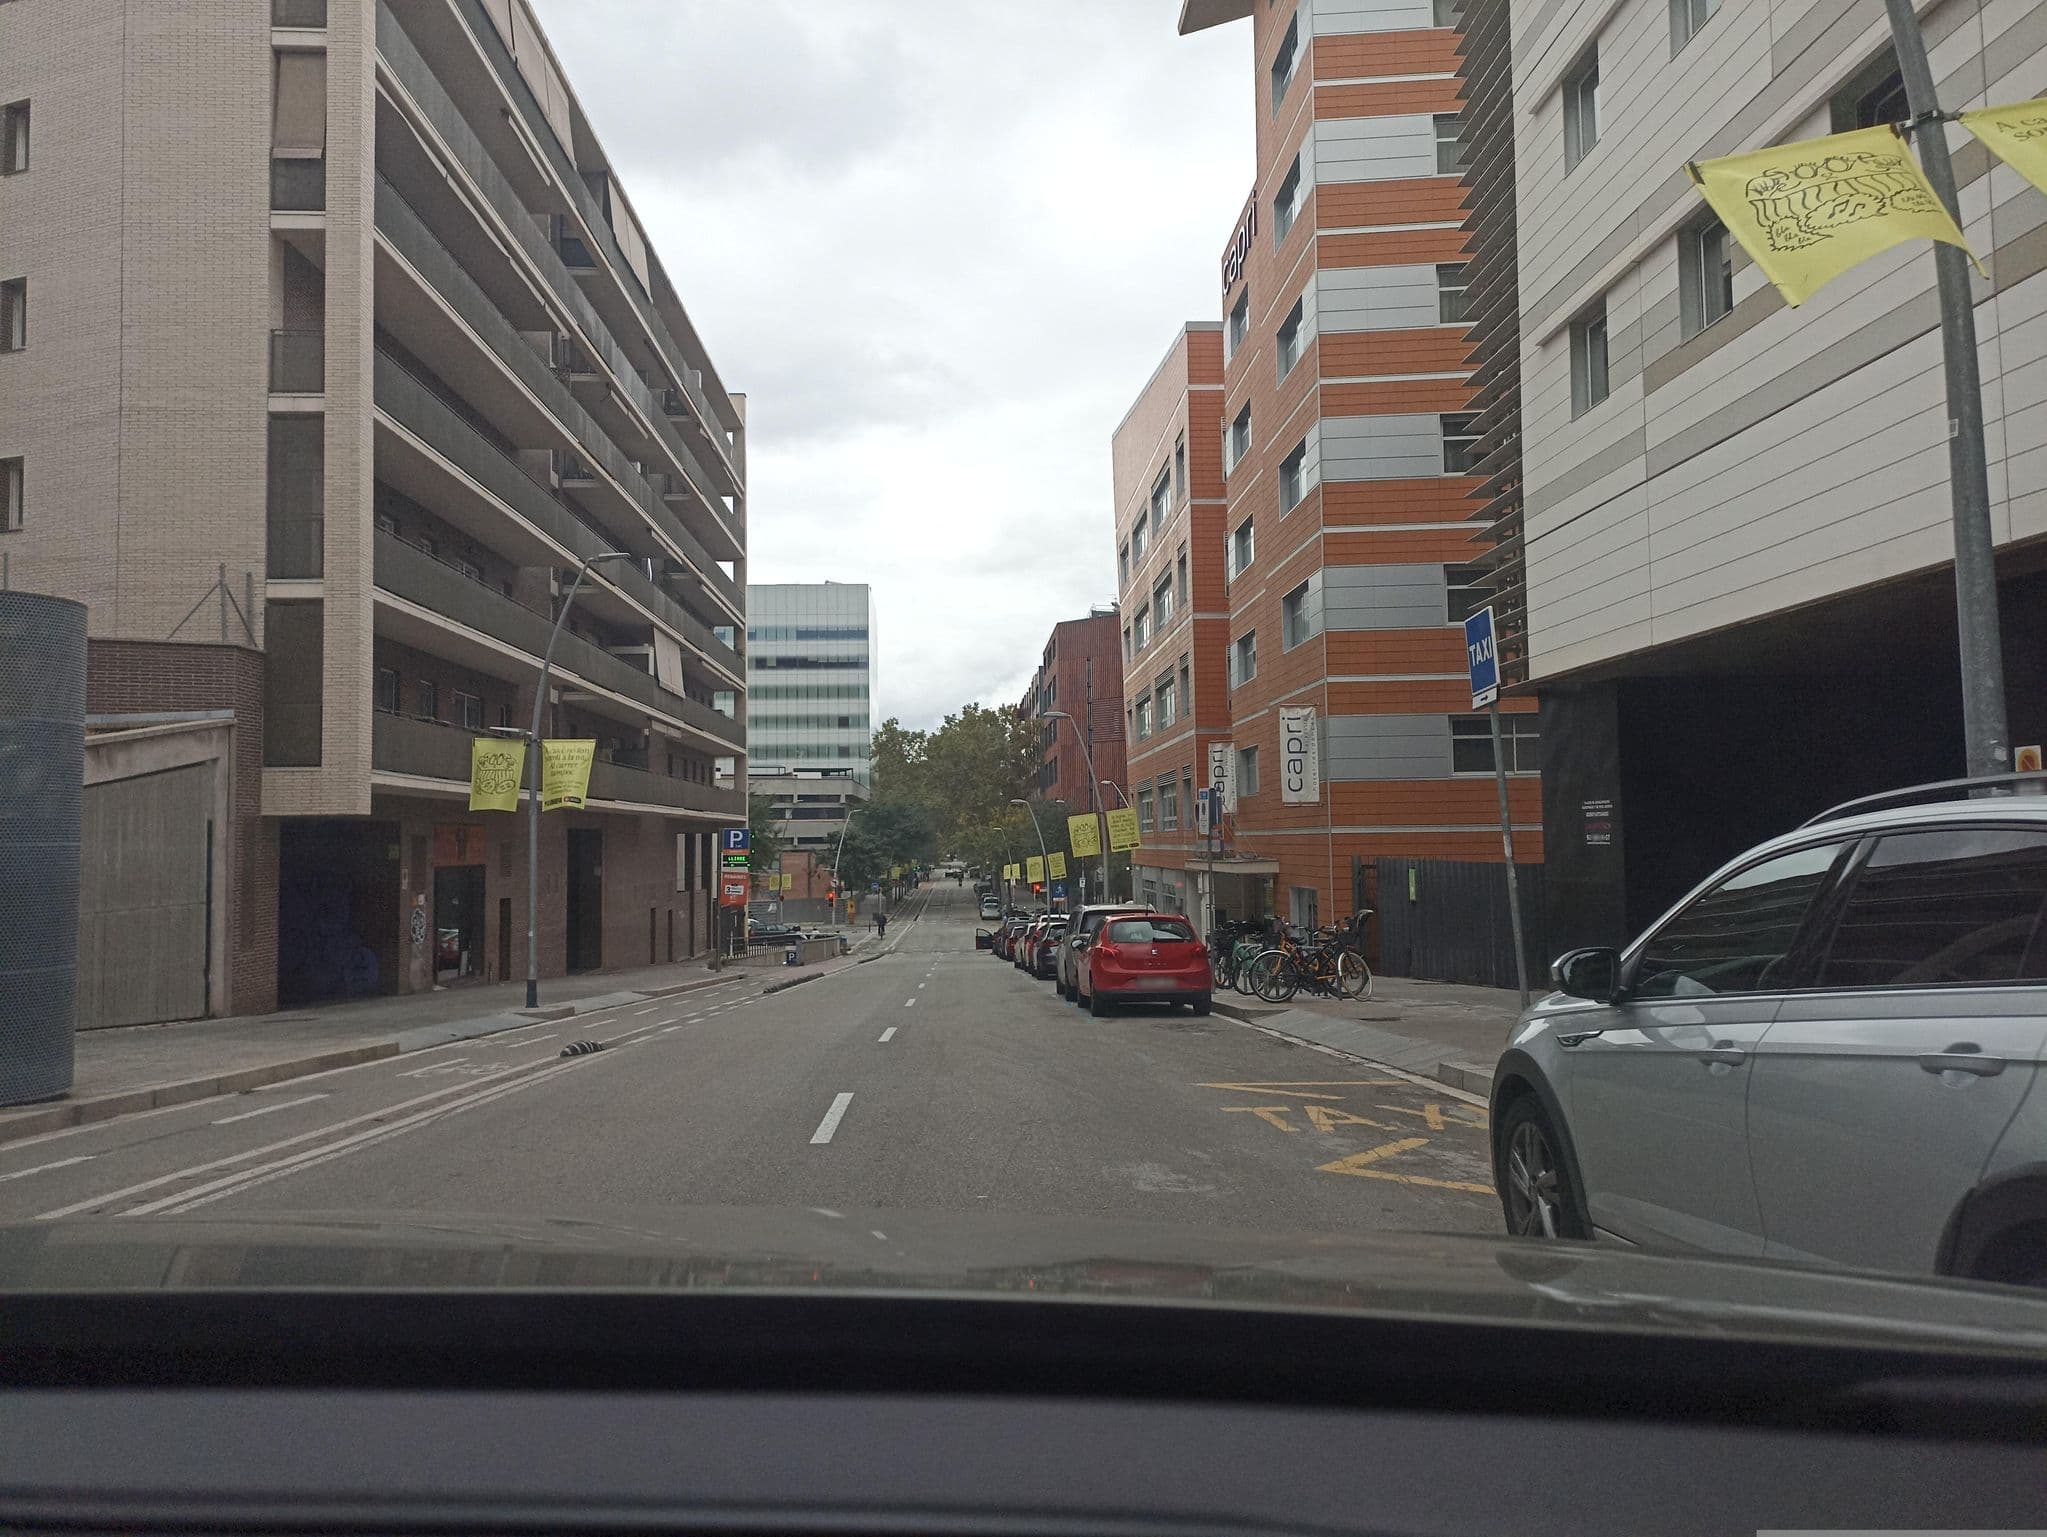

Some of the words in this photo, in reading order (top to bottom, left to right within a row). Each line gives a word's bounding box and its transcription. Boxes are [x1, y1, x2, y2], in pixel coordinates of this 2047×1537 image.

[1222, 190, 1257, 295] capri
[1469, 635, 1493, 667] TAXI
[1282, 716, 1308, 792] capri
[730, 830, 743, 848] P
[788, 952, 795, 961] P
